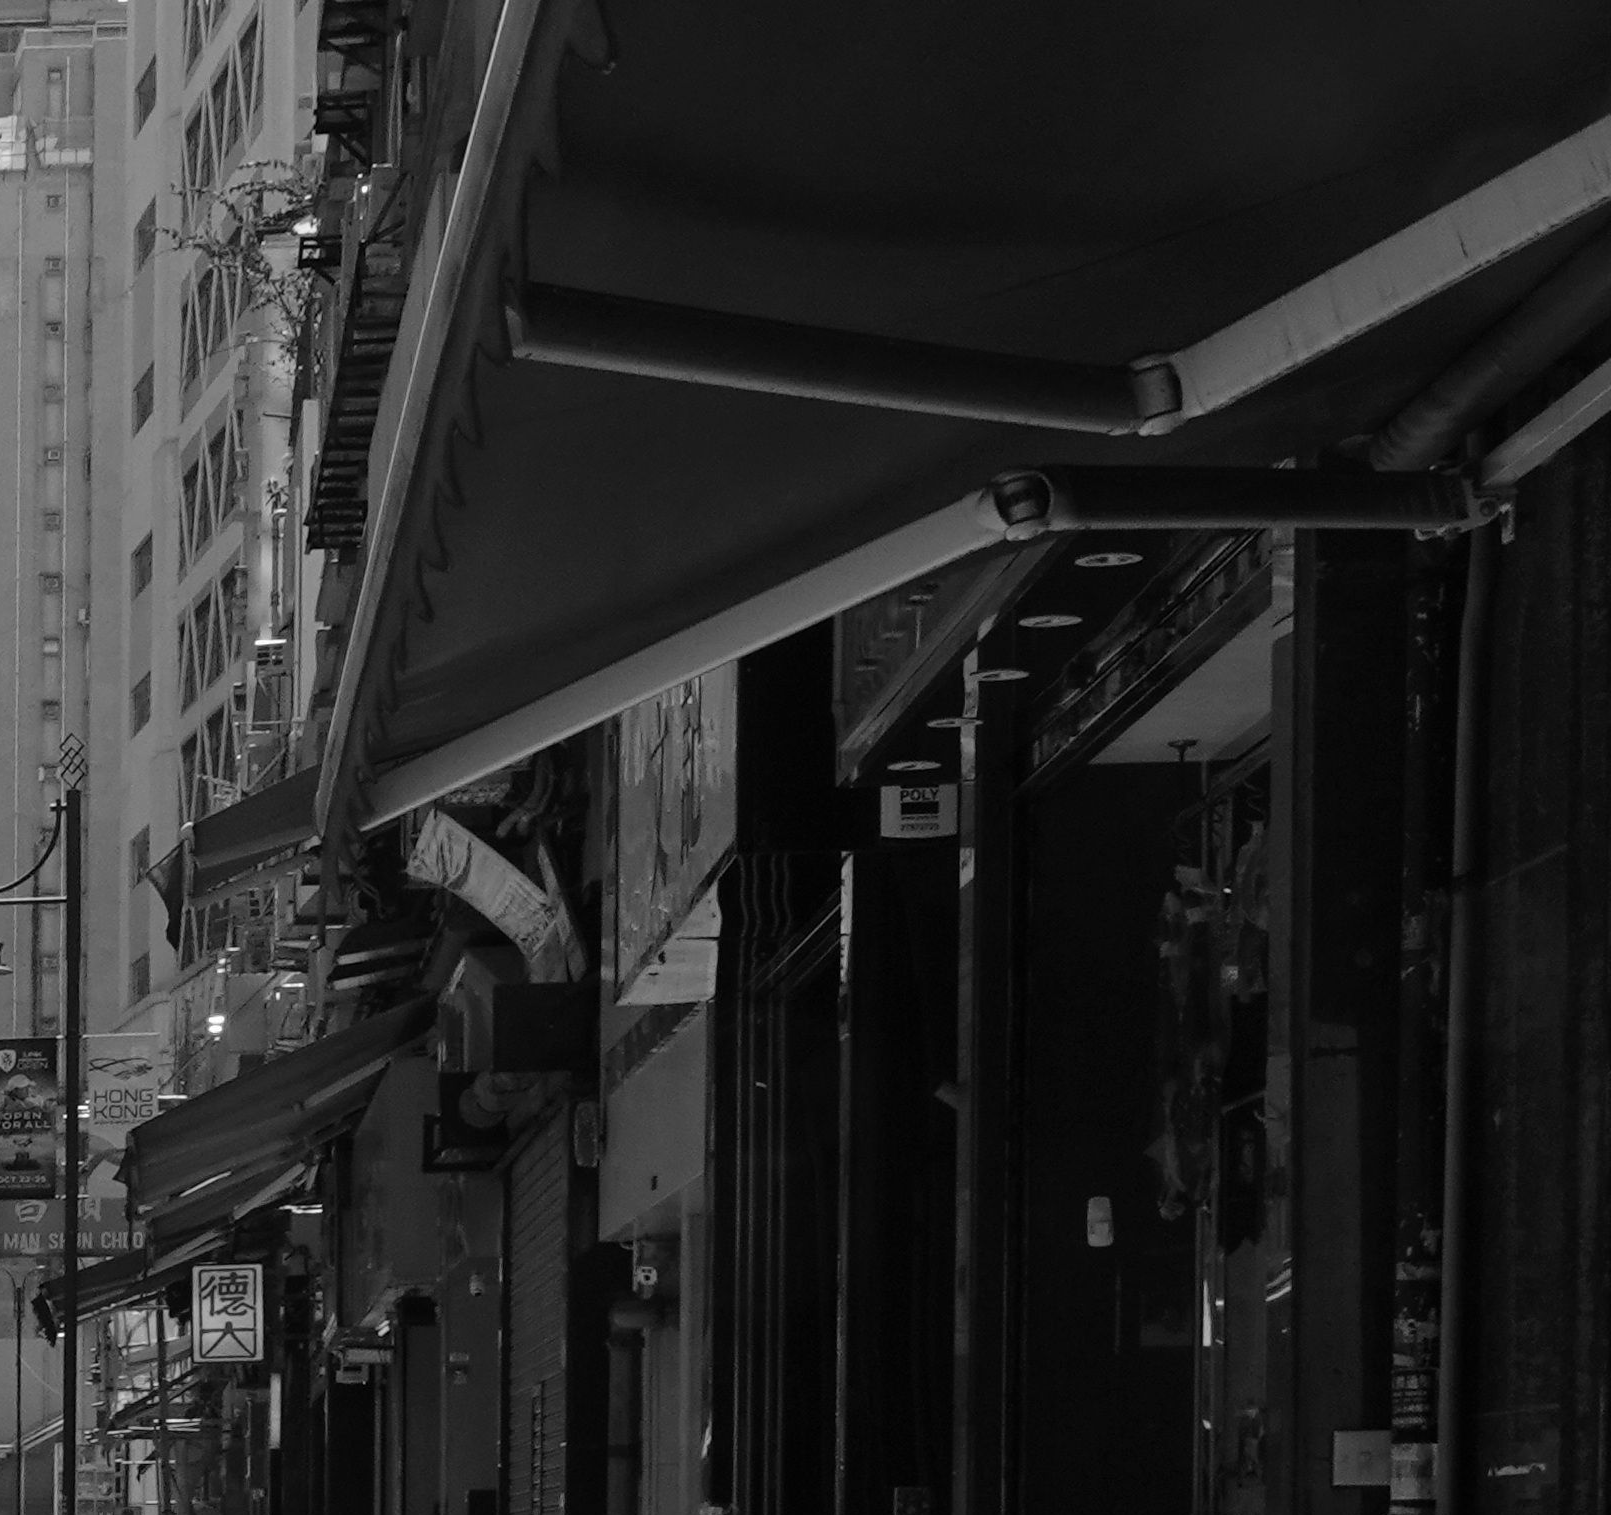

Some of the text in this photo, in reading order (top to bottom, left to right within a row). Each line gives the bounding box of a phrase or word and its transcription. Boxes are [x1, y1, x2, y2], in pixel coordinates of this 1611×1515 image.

[900, 788, 939, 801] POLY
[93, 1088, 153, 1103] HONG
[3, 1112, 42, 1120] OPEN
[93, 1104, 153, 1119] KONG
[24, 1120, 51, 1129] ALL
[3, 1232, 41, 1250] MAN
[200, 1271, 255, 1358] 德大
